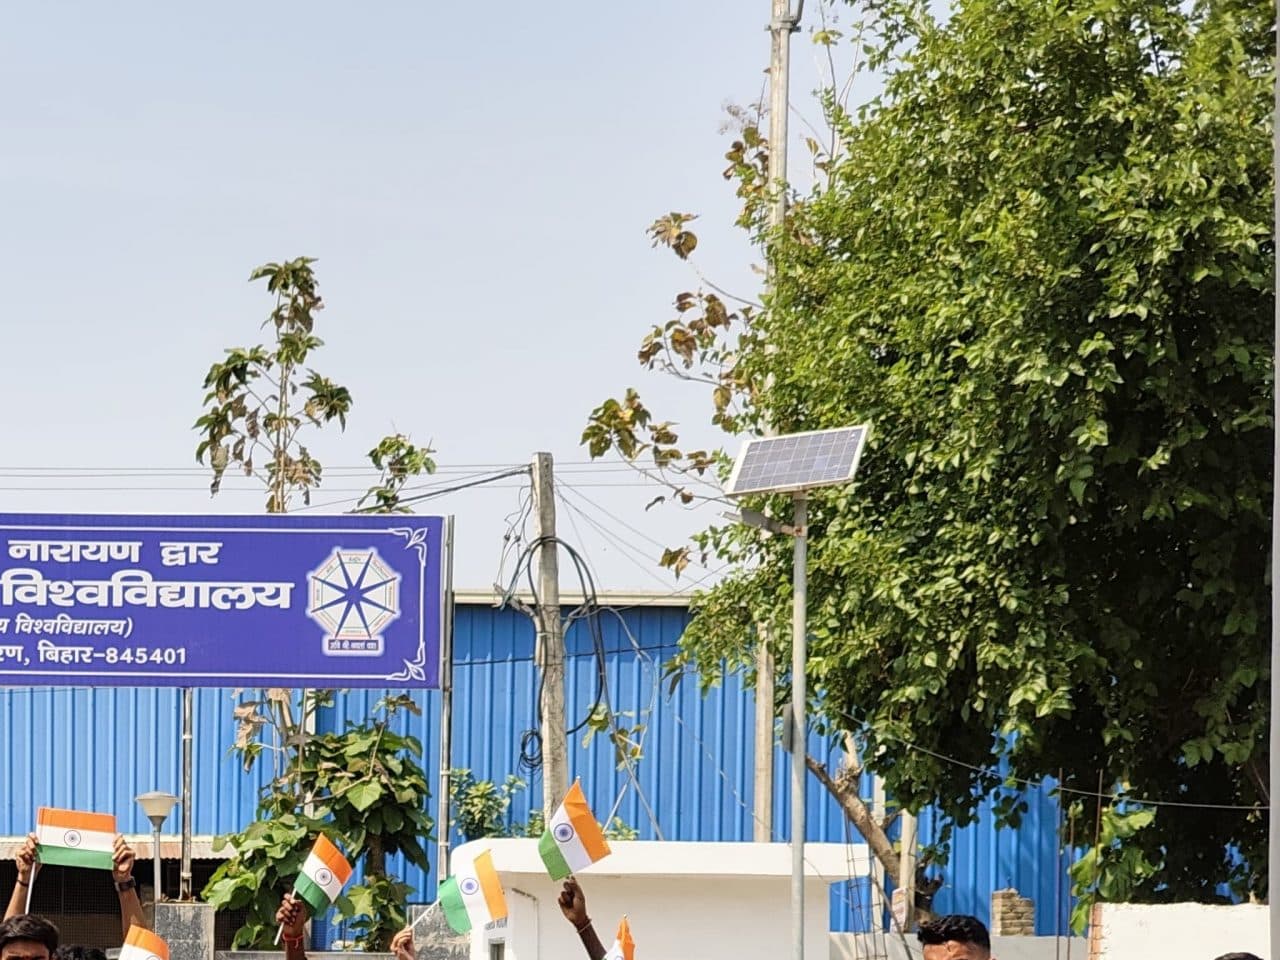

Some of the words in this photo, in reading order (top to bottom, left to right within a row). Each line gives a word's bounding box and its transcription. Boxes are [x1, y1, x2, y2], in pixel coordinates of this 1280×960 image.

[8, 539, 143, 563] नारायण
[160, 541, 223, 567] द्वार
[0, 567, 296, 611] विश्वविद्यालय
[14, 612, 134, 639] विश्वविद्यालय)
